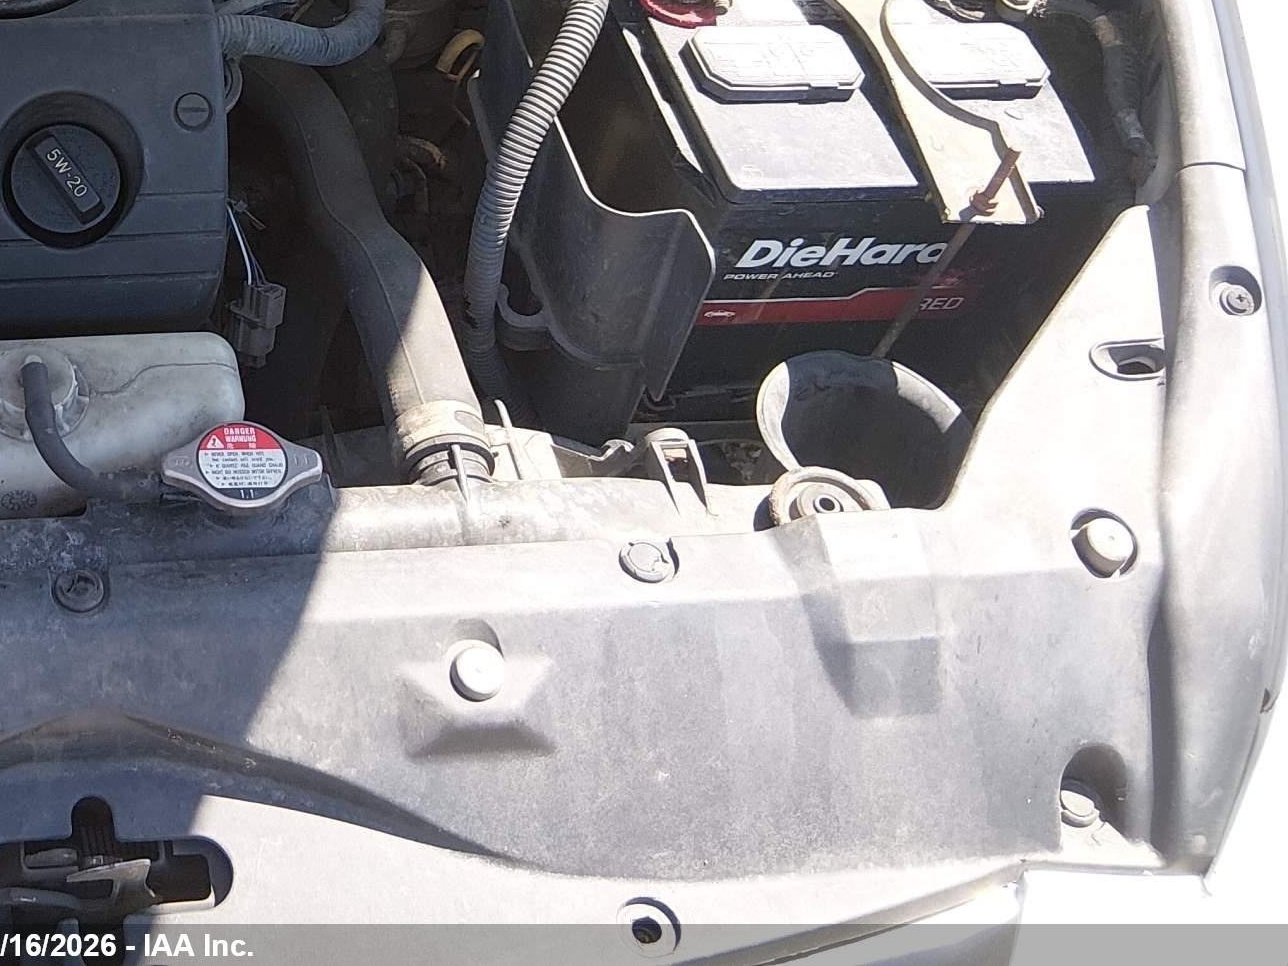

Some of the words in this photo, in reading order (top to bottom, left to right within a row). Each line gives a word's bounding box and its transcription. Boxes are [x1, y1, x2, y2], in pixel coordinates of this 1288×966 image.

[46, 148, 88, 198] 5W-20
[723, 273, 778, 281] POWER
[781, 271, 835, 279] AHEAD
[240, 489, 255, 498] 1.1
